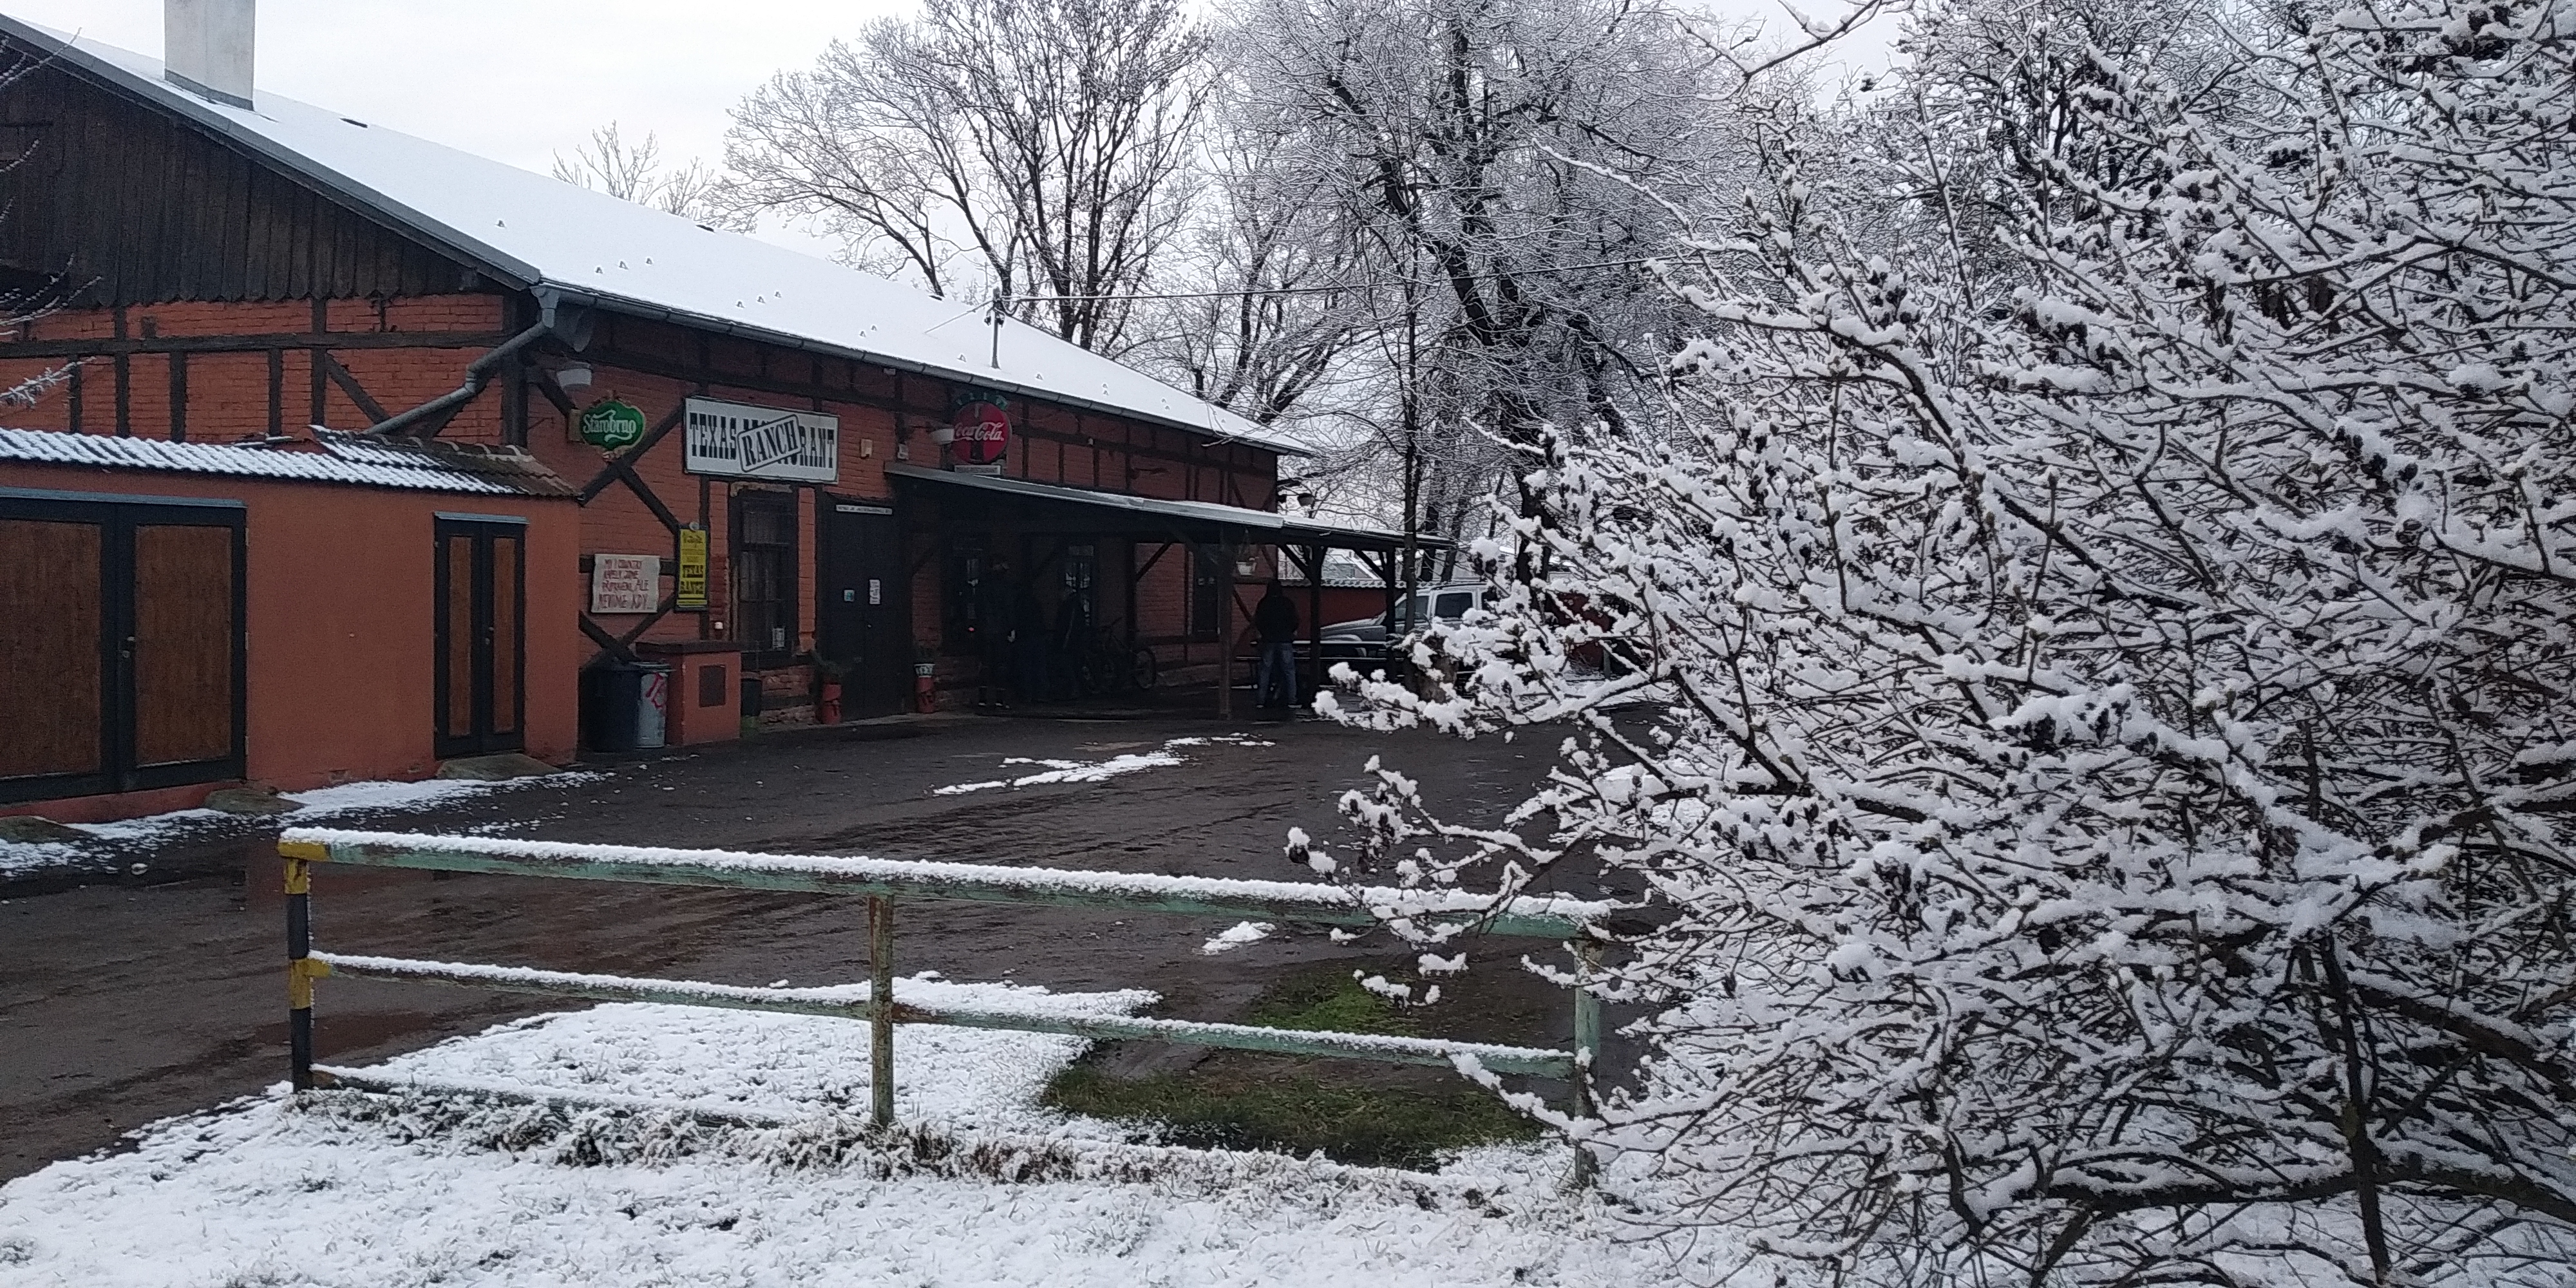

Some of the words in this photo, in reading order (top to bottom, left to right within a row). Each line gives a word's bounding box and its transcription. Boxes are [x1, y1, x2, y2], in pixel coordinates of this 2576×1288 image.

[583, 409, 636, 442] Starobrno
[689, 412, 736, 460] TEXAS
[742, 420, 798, 467] RANCH
